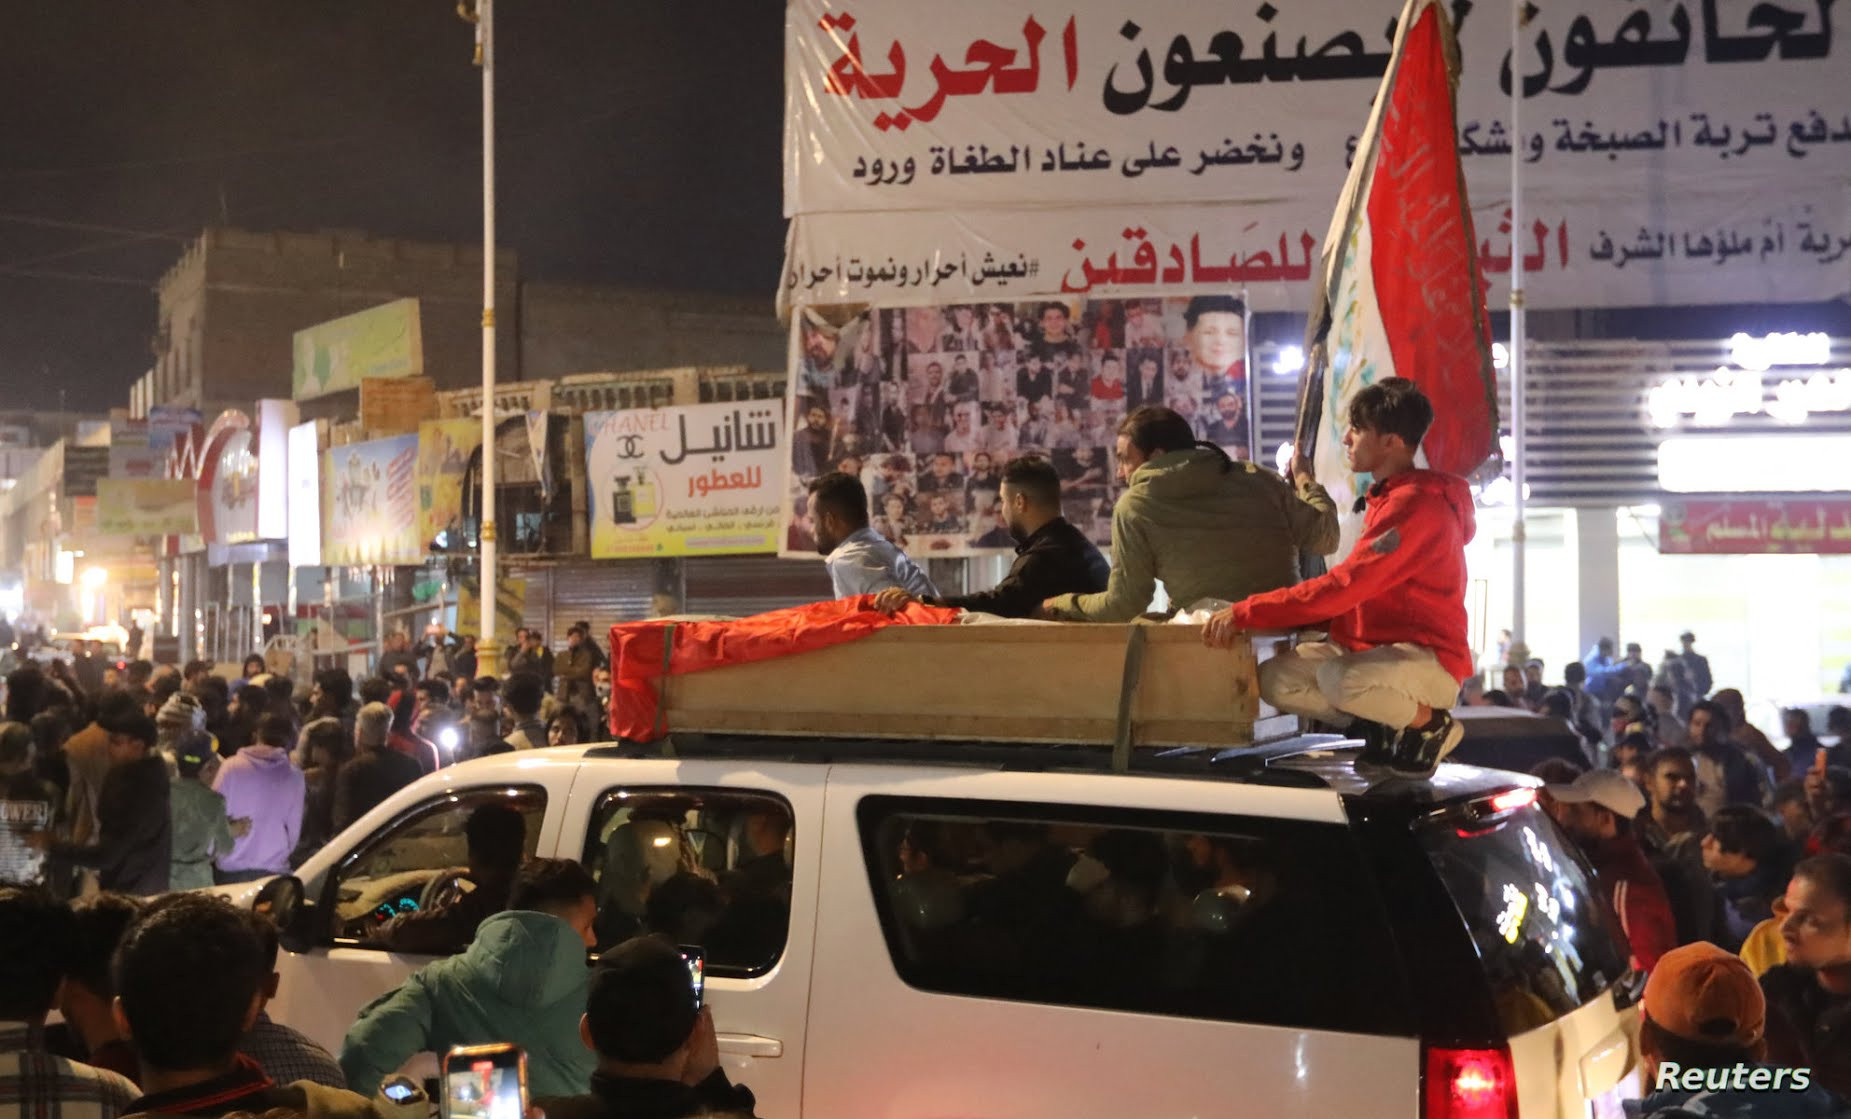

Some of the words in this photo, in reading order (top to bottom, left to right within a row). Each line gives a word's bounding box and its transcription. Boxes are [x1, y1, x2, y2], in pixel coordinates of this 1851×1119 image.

[818, 12, 1078, 132] الحرية
[1188, 132, 1305, 176] ونخضر
[1553, 118, 1681, 161] الصبخة
[1690, 113, 1777, 160] تربة
[853, 155, 916, 186] ورود
[929, 143, 1031, 176] الطغاة
[1041, 141, 1112, 172] عناد
[1122, 140, 1182, 178] على
[1590, 226, 1675, 269] الشرف
[846, 256, 908, 288] ونموت
[911, 252, 968, 287] أحرار
[971, 252, 1041, 286] #نعيش
[660, 410, 776, 465] شانيل
[688, 465, 762, 498] للعطور
